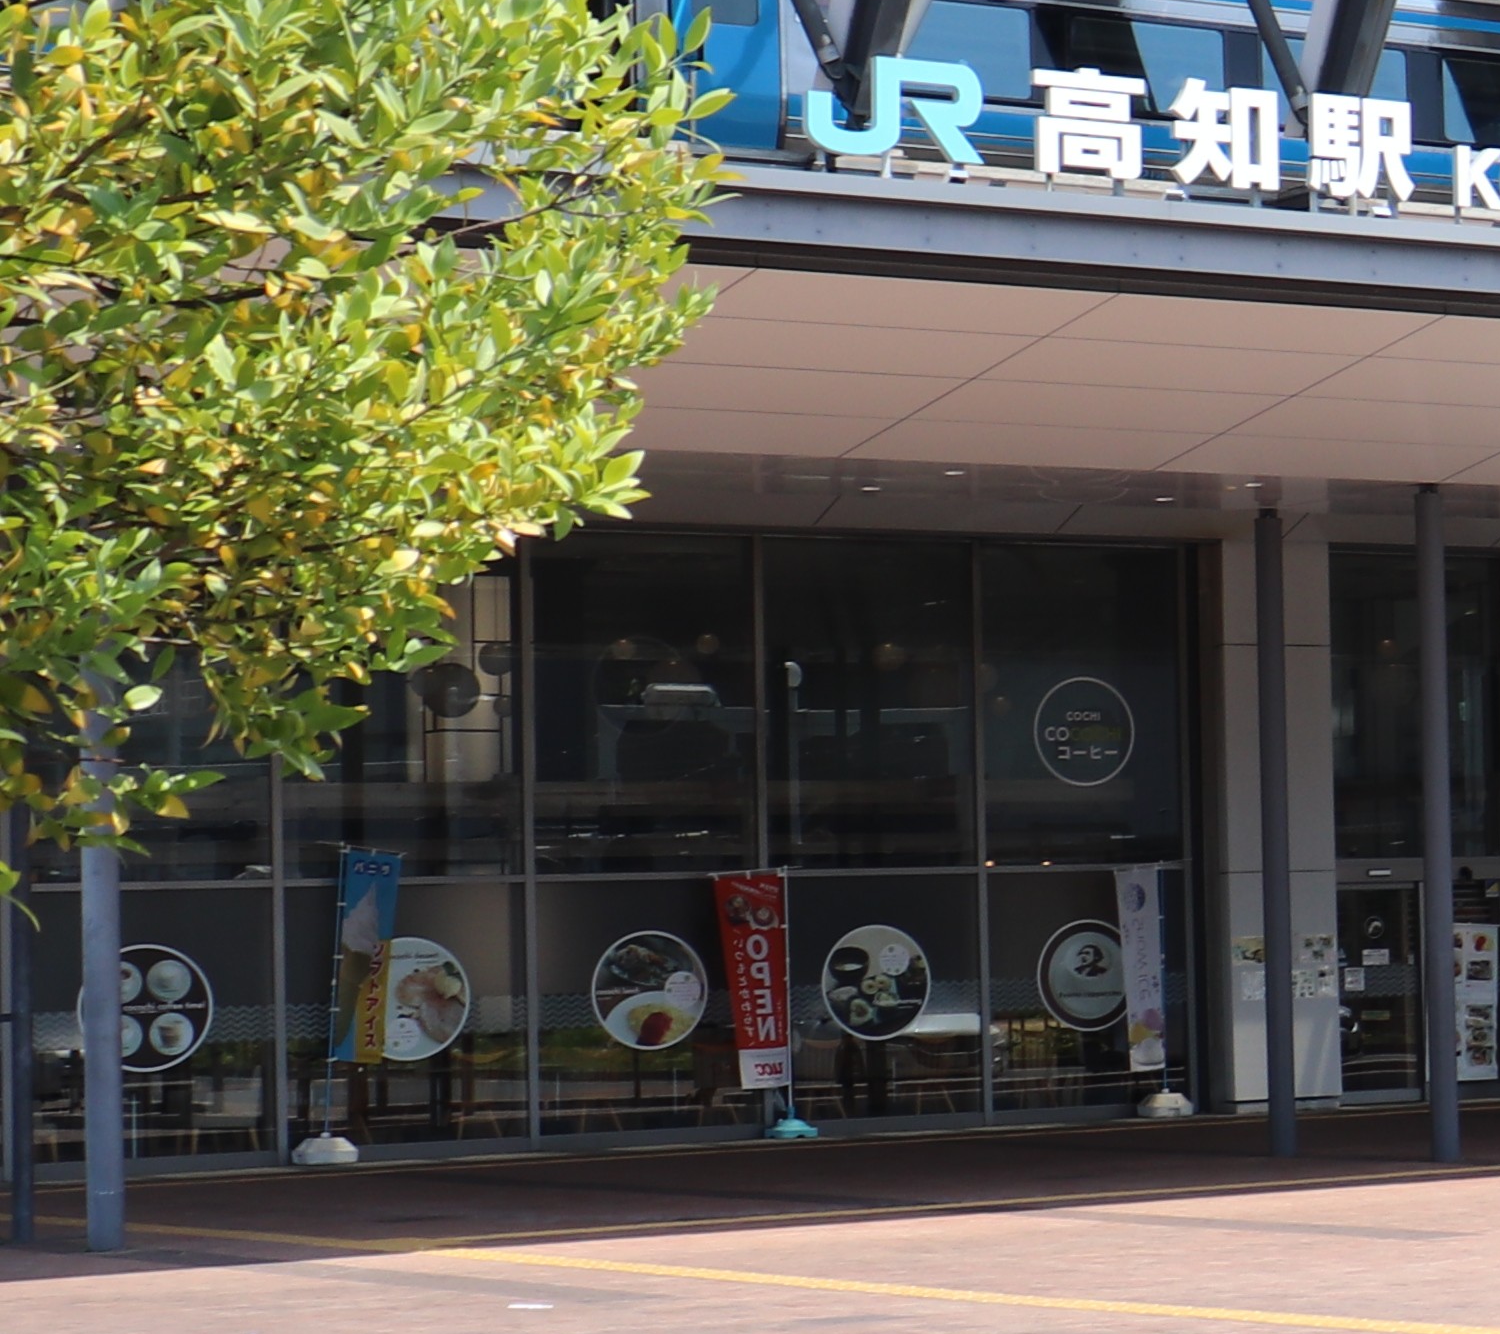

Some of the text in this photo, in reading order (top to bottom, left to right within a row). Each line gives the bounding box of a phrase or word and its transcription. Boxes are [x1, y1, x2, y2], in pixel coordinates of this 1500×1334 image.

[804, 55, 986, 165] JR
[1030, 68, 1414, 202] 高知駅
[1066, 711, 1101, 722] COCHI
[1057, 745, 1119, 760] コーヒー
[365, 943, 384, 1049] ソフトアイス
